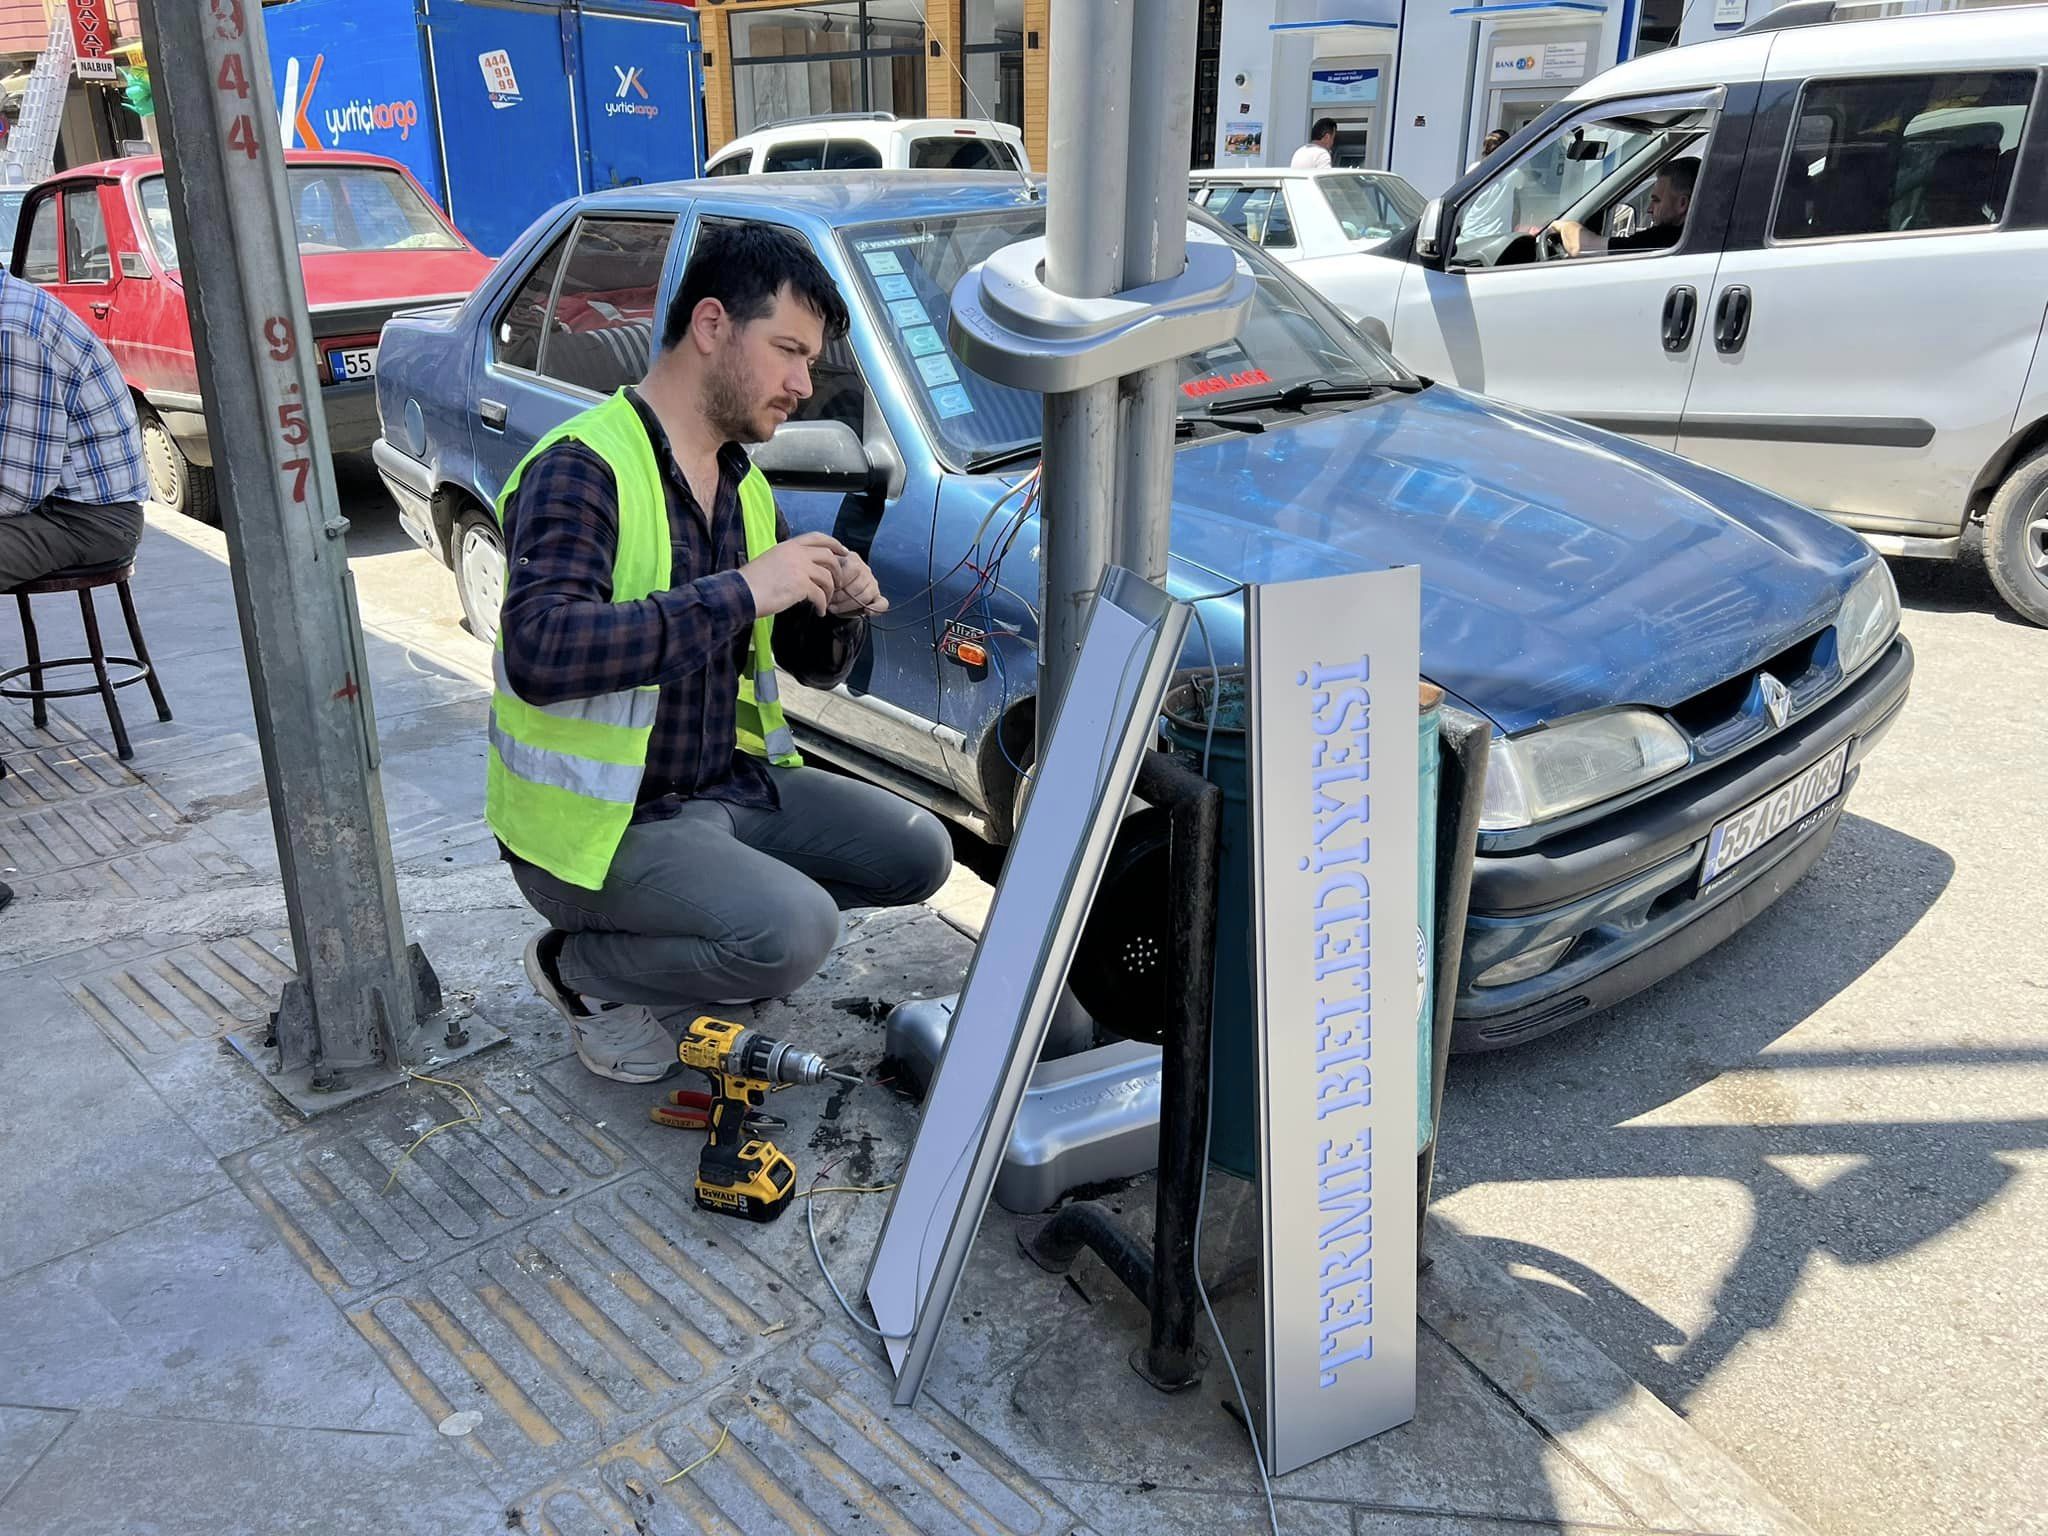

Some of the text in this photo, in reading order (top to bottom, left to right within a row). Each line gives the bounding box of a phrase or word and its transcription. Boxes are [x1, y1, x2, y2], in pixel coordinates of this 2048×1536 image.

[80, 61, 113, 73] NALBUR
[344, 352, 371, 374] 55
[1297, 653, 1373, 1389] TERME BELEDİYESİ
